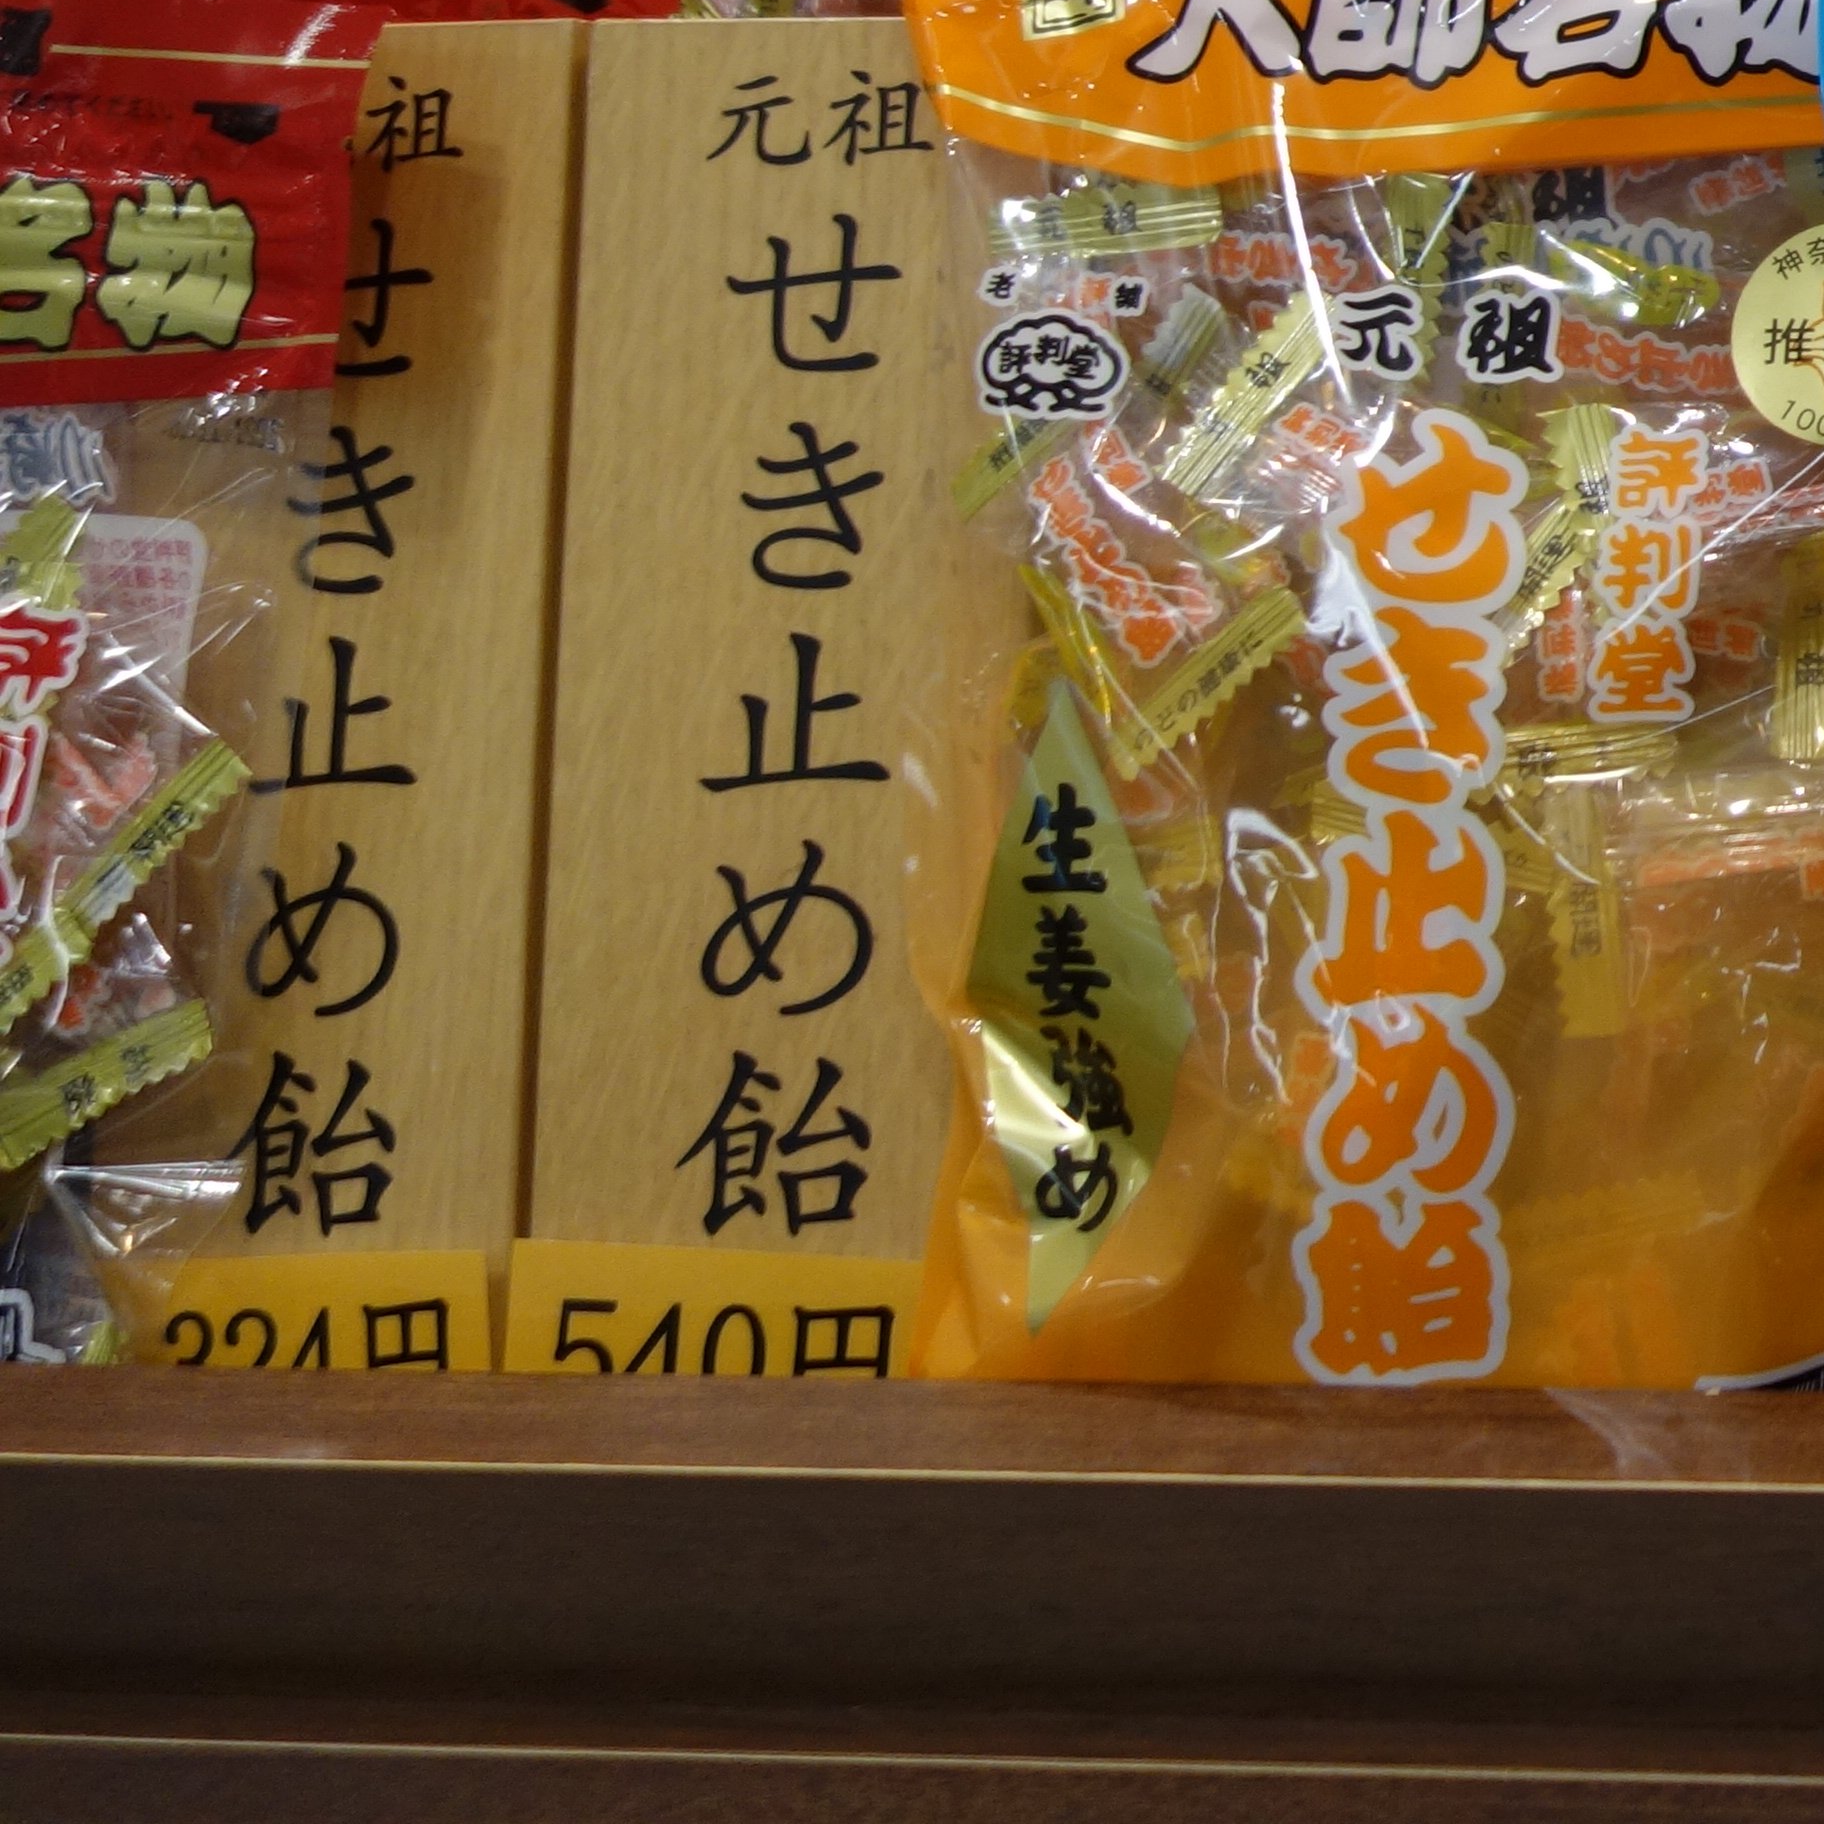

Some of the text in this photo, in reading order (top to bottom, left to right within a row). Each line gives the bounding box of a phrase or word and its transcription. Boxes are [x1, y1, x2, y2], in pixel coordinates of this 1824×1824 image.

[366, 76, 465, 174] 祖
[706, 69, 936, 167] 元祖
[998, 333, 1100, 380] 評判堂
[1342, 290, 1556, 378] 元祖
[1596, 429, 1702, 716] 評判堂
[230, 218, 434, 1236] せき止め飴
[676, 213, 903, 1236] せき止め飴
[1021, 782, 1135, 1233] 生姜強め
[1308, 422, 1515, 1373] せき止め飴
